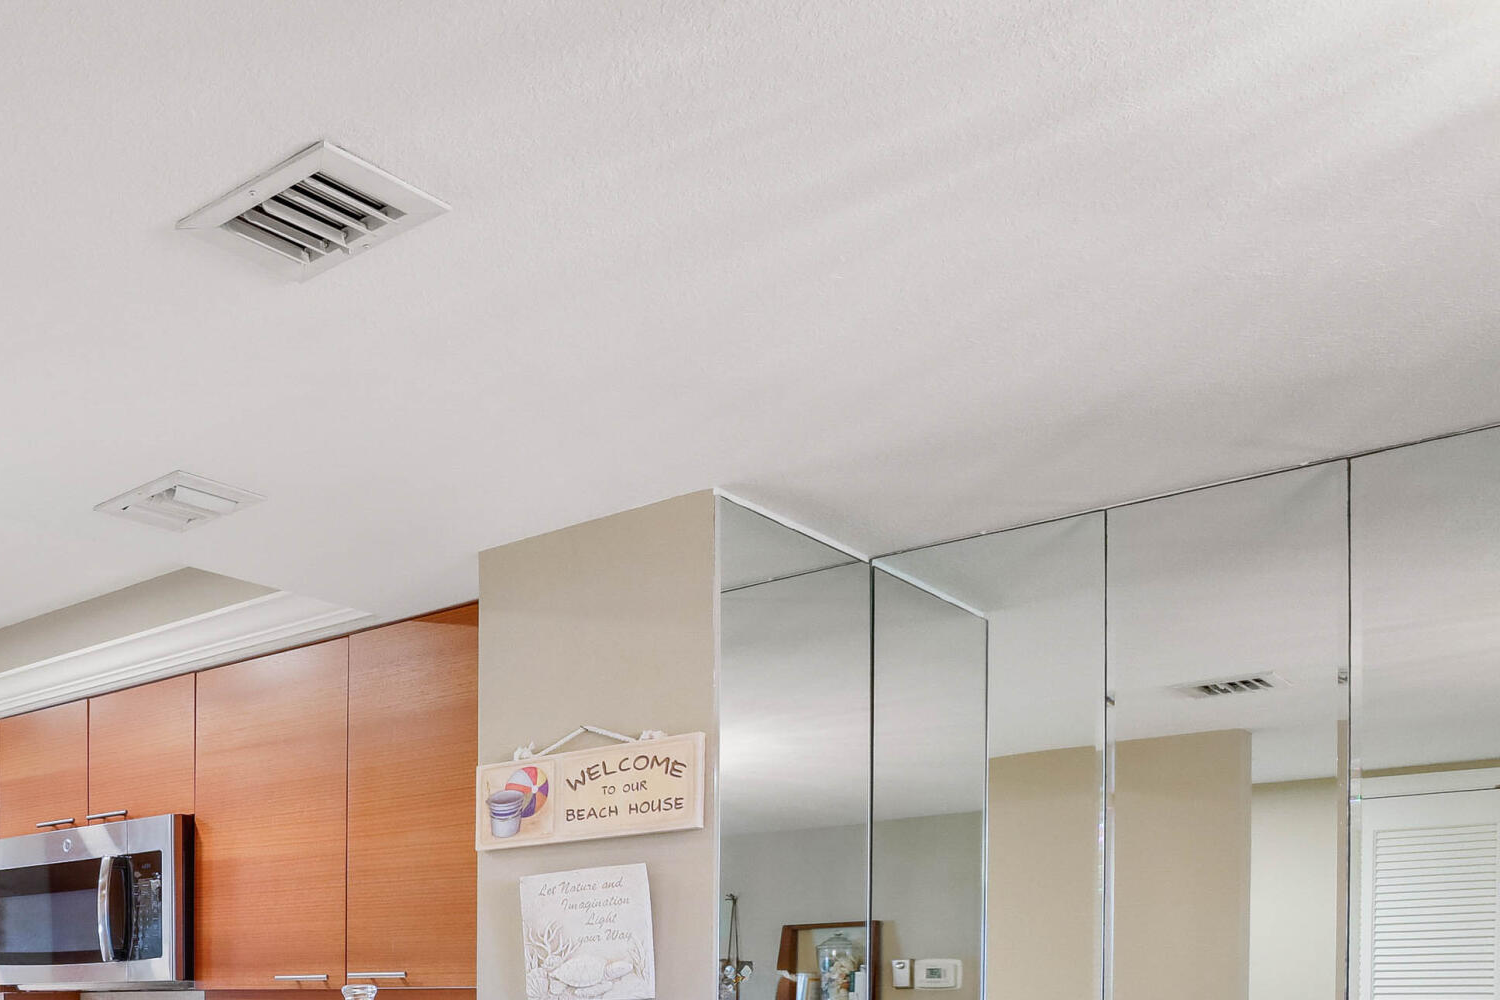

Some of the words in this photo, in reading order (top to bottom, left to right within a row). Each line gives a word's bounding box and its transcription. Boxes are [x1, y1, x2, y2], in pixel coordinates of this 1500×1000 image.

[566, 754, 687, 791] WELCOME
[601, 786, 616, 795] TO
[622, 780, 648, 793] OUR
[566, 805, 618, 821] BEACH
[628, 797, 684, 814] HOUSE
[538, 884, 556, 896] Let
[559, 881, 597, 894] Nature
[601, 876, 623, 889] and
[561, 896, 630, 912] Imagination
[585, 911, 617, 929] Light
[577, 934, 601, 945] your
[604, 929, 633, 941] Way
